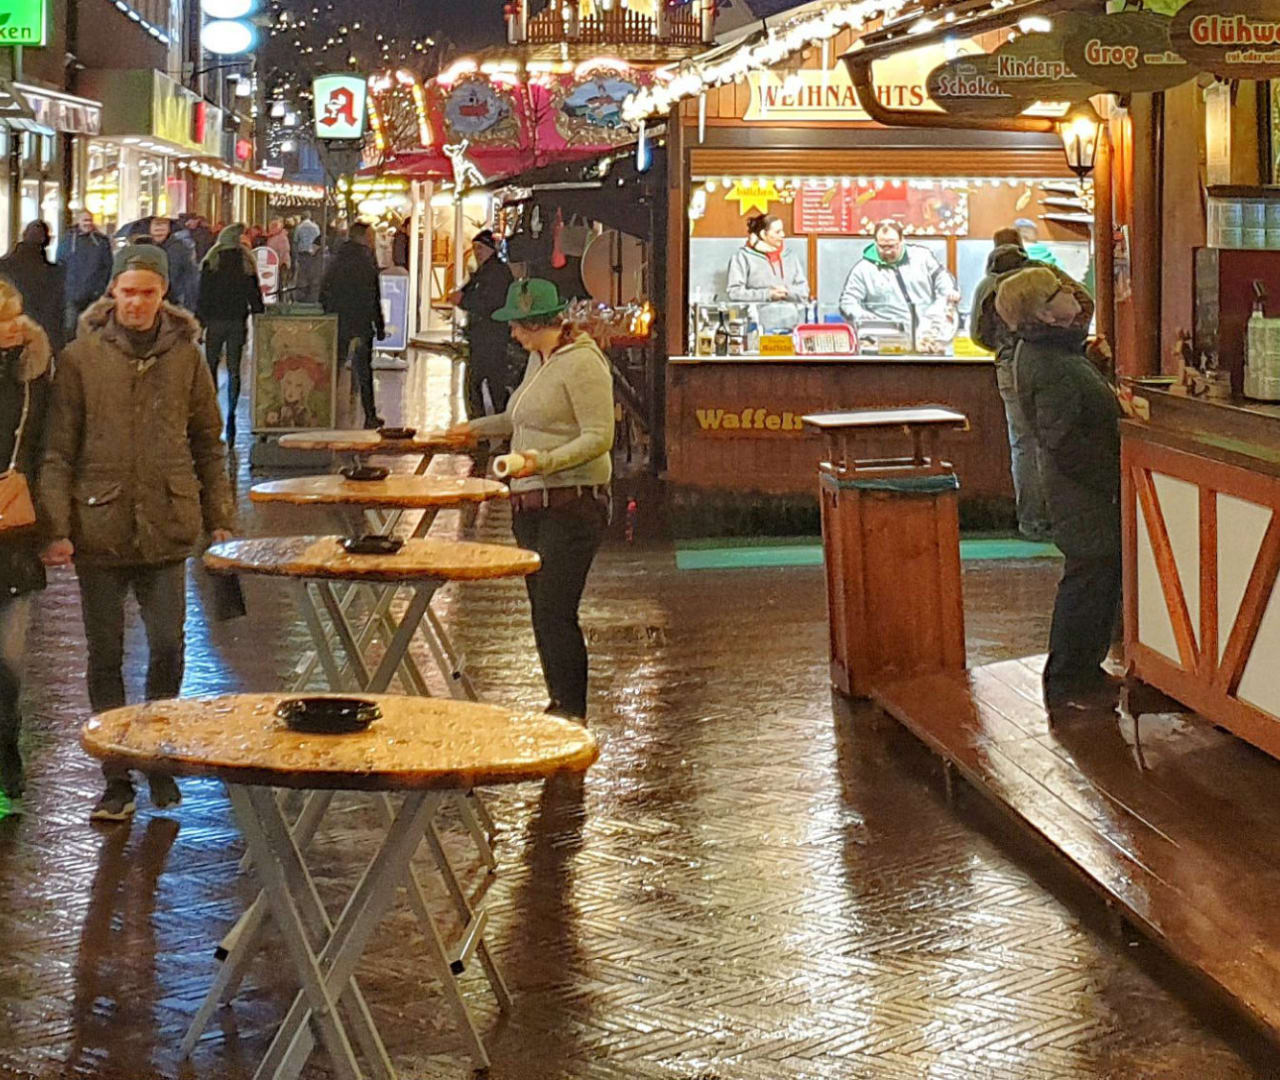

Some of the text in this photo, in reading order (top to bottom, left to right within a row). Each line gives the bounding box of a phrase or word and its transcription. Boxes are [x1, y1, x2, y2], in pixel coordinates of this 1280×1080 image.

[1084, 38, 1139, 69] Grog
[998, 55, 1077, 77] Kinderpu
[938, 74, 1013, 97] Schoko
